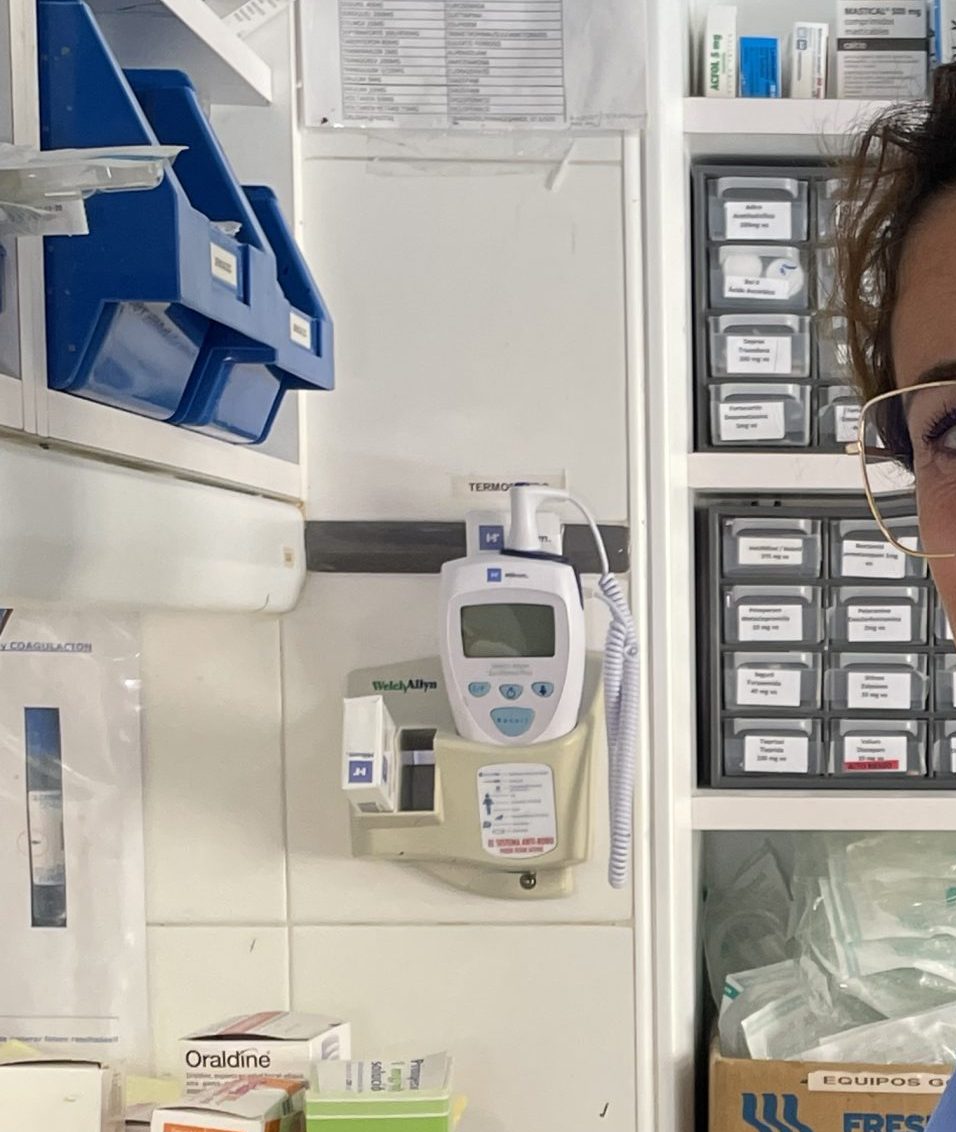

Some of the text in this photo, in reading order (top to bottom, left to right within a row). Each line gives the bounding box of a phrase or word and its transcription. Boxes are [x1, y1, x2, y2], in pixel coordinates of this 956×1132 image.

[186, 1050, 271, 1068] Oraldine
[822, 1076, 945, 1088] EQUIPOS G
